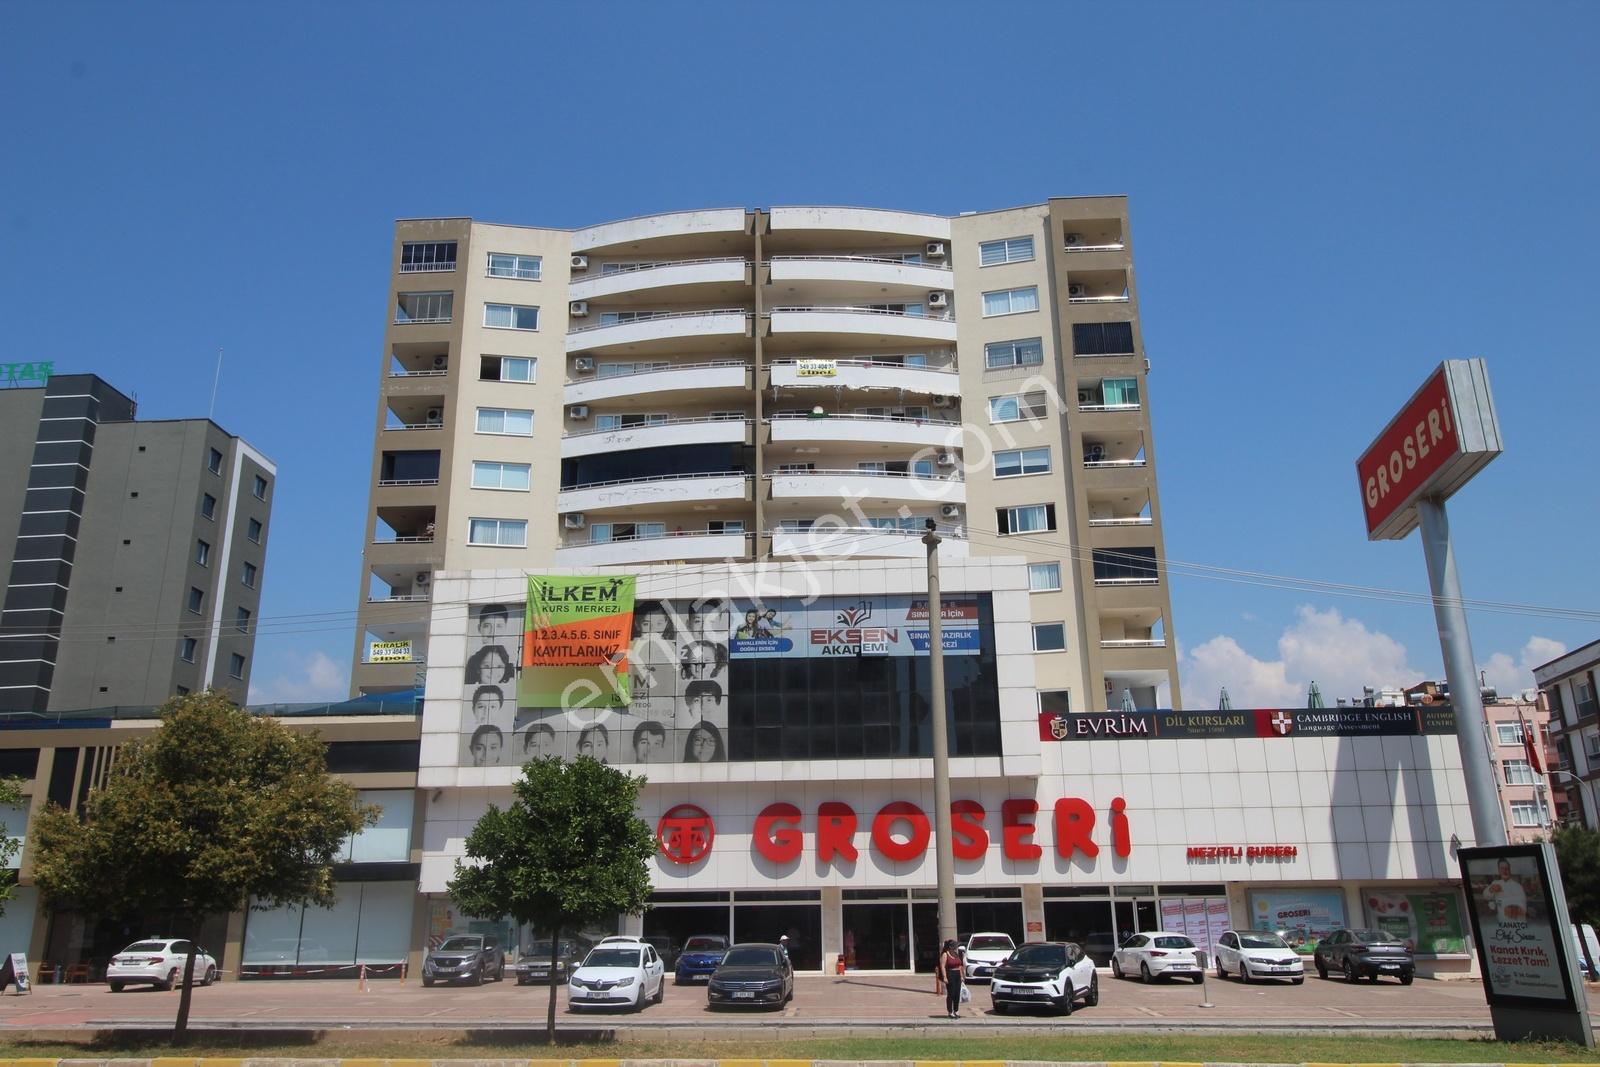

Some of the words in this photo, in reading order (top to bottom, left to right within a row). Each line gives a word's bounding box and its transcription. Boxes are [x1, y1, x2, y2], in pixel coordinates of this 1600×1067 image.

[541, 581, 618, 602] İLKEM
[542, 605, 570, 613] KURS
[575, 605, 621, 613] MERKEZİ
[948, 609, 964, 619] İÇİN
[593, 630, 622, 640] SINIF
[810, 628, 899, 645] EKSEN
[1165, 715, 1186, 727] DİL
[1188, 715, 1246, 726] KURSLARI
[1297, 713, 1362, 723] CAMBRIDGE
[1365, 712, 1412, 722] ENGLISH
[1076, 714, 1149, 734] EVRİM
[1298, 723, 1336, 732] Language
[753, 797, 1131, 863] GROSERİ
[1490, 945, 1519, 954] Kanat
[1492, 955, 1523, 965] Lezzet
[1523, 957, 1550, 967] Tam!
